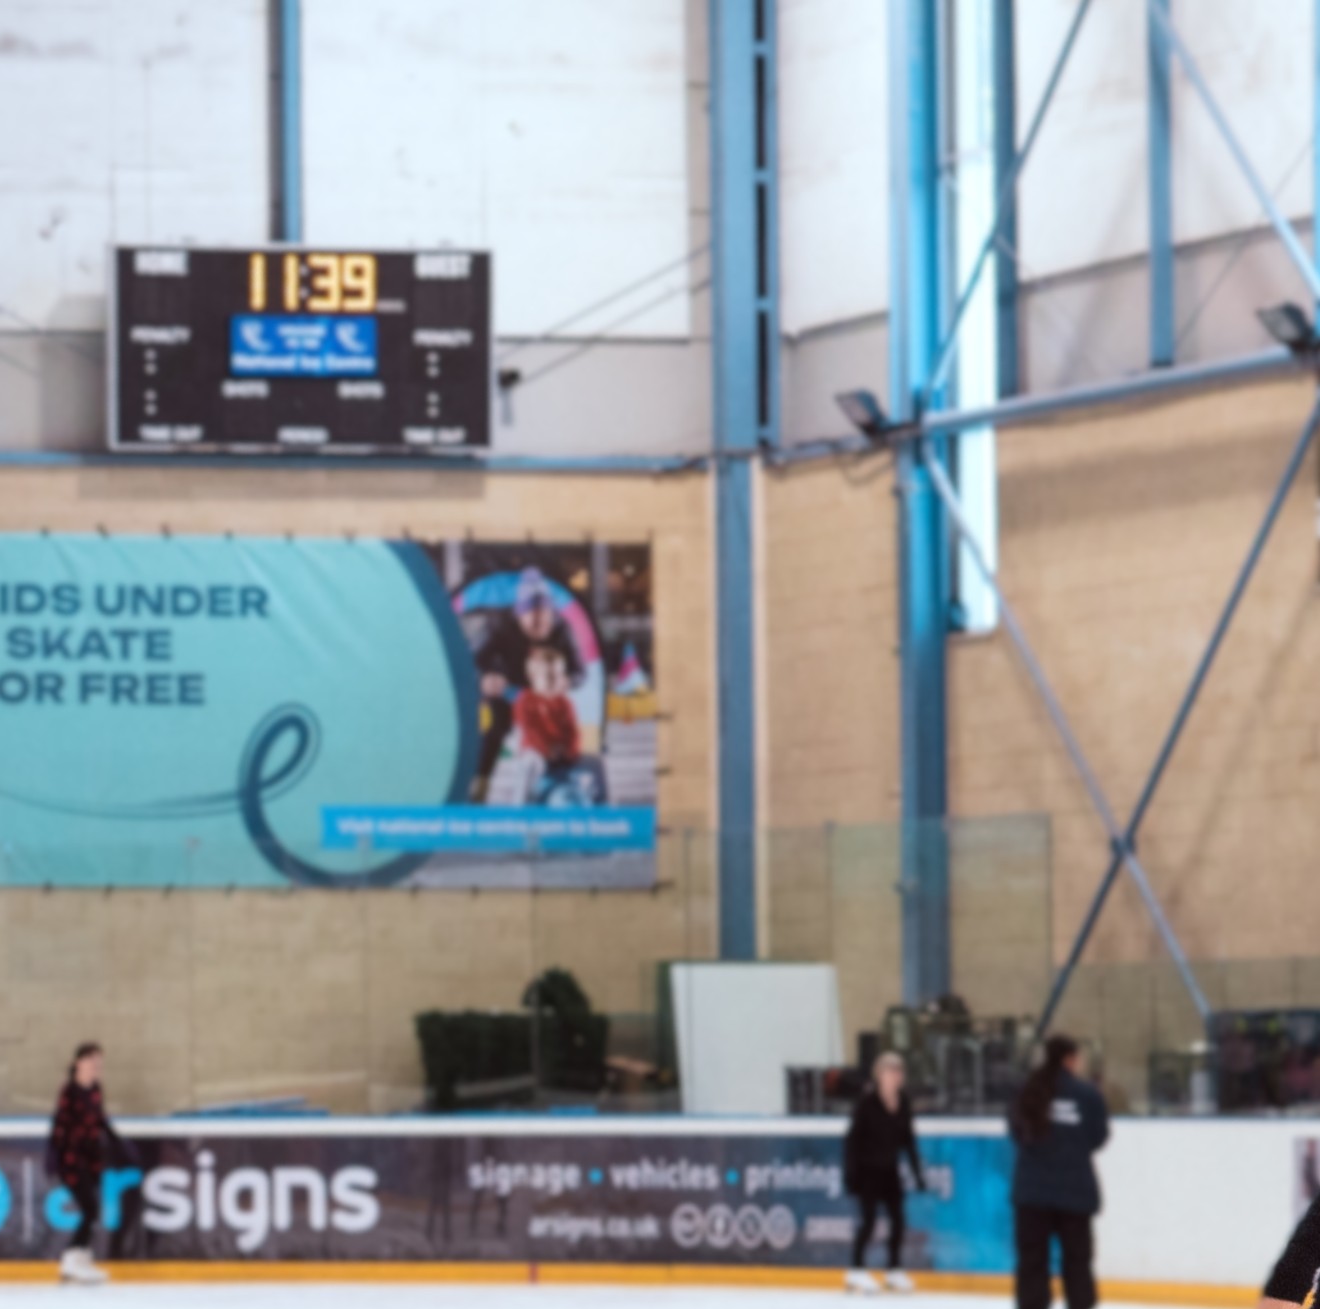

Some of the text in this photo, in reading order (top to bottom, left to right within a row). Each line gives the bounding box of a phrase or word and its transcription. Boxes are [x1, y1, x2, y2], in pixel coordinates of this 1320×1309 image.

[248, 252, 378, 313] 11:39
[93, 584, 269, 620] UNDER
[5, 626, 173, 663] SKATE
[78, 672, 206, 708] FREE
[468, 1156, 843, 1199] signage vehicles printing
